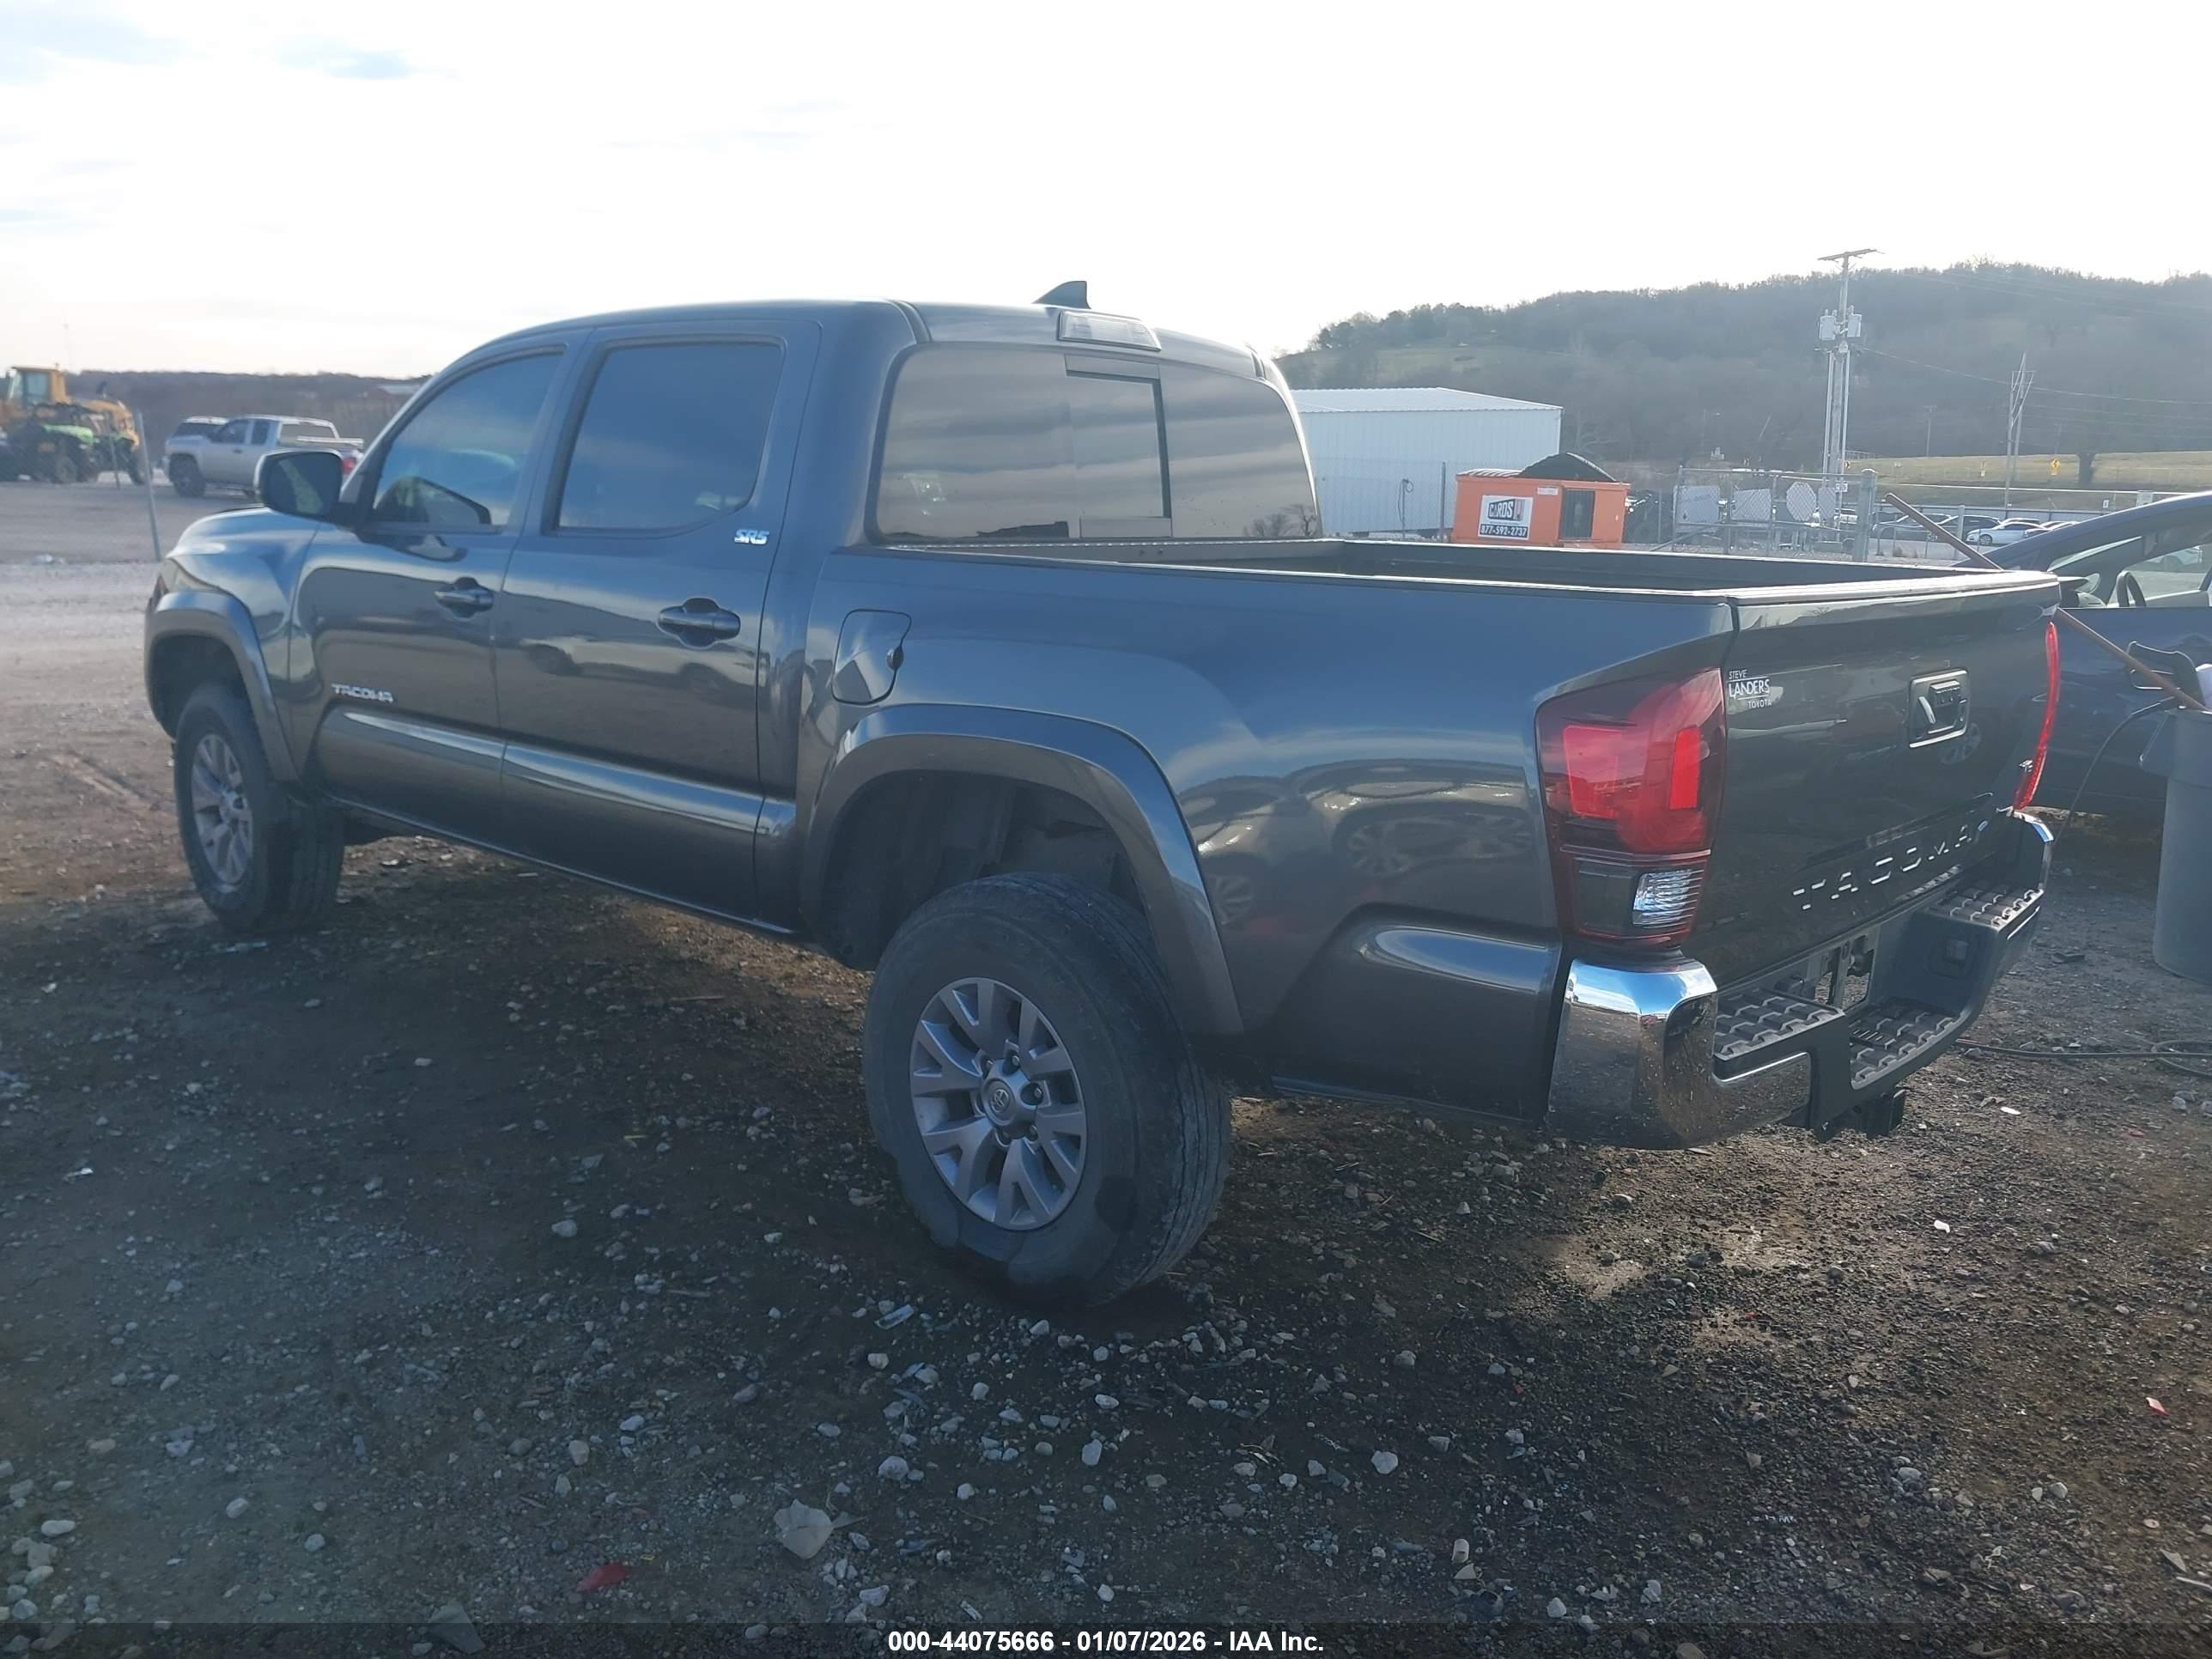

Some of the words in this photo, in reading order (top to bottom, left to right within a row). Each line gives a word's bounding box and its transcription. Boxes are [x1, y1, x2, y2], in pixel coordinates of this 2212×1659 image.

[734, 529, 769, 544] SR5
[1729, 669, 1747, 679] STEVE
[331, 683, 394, 702] TACOMA
[1729, 678, 1770, 699] LANDERS
[1747, 699, 1771, 709] TOYOTA
